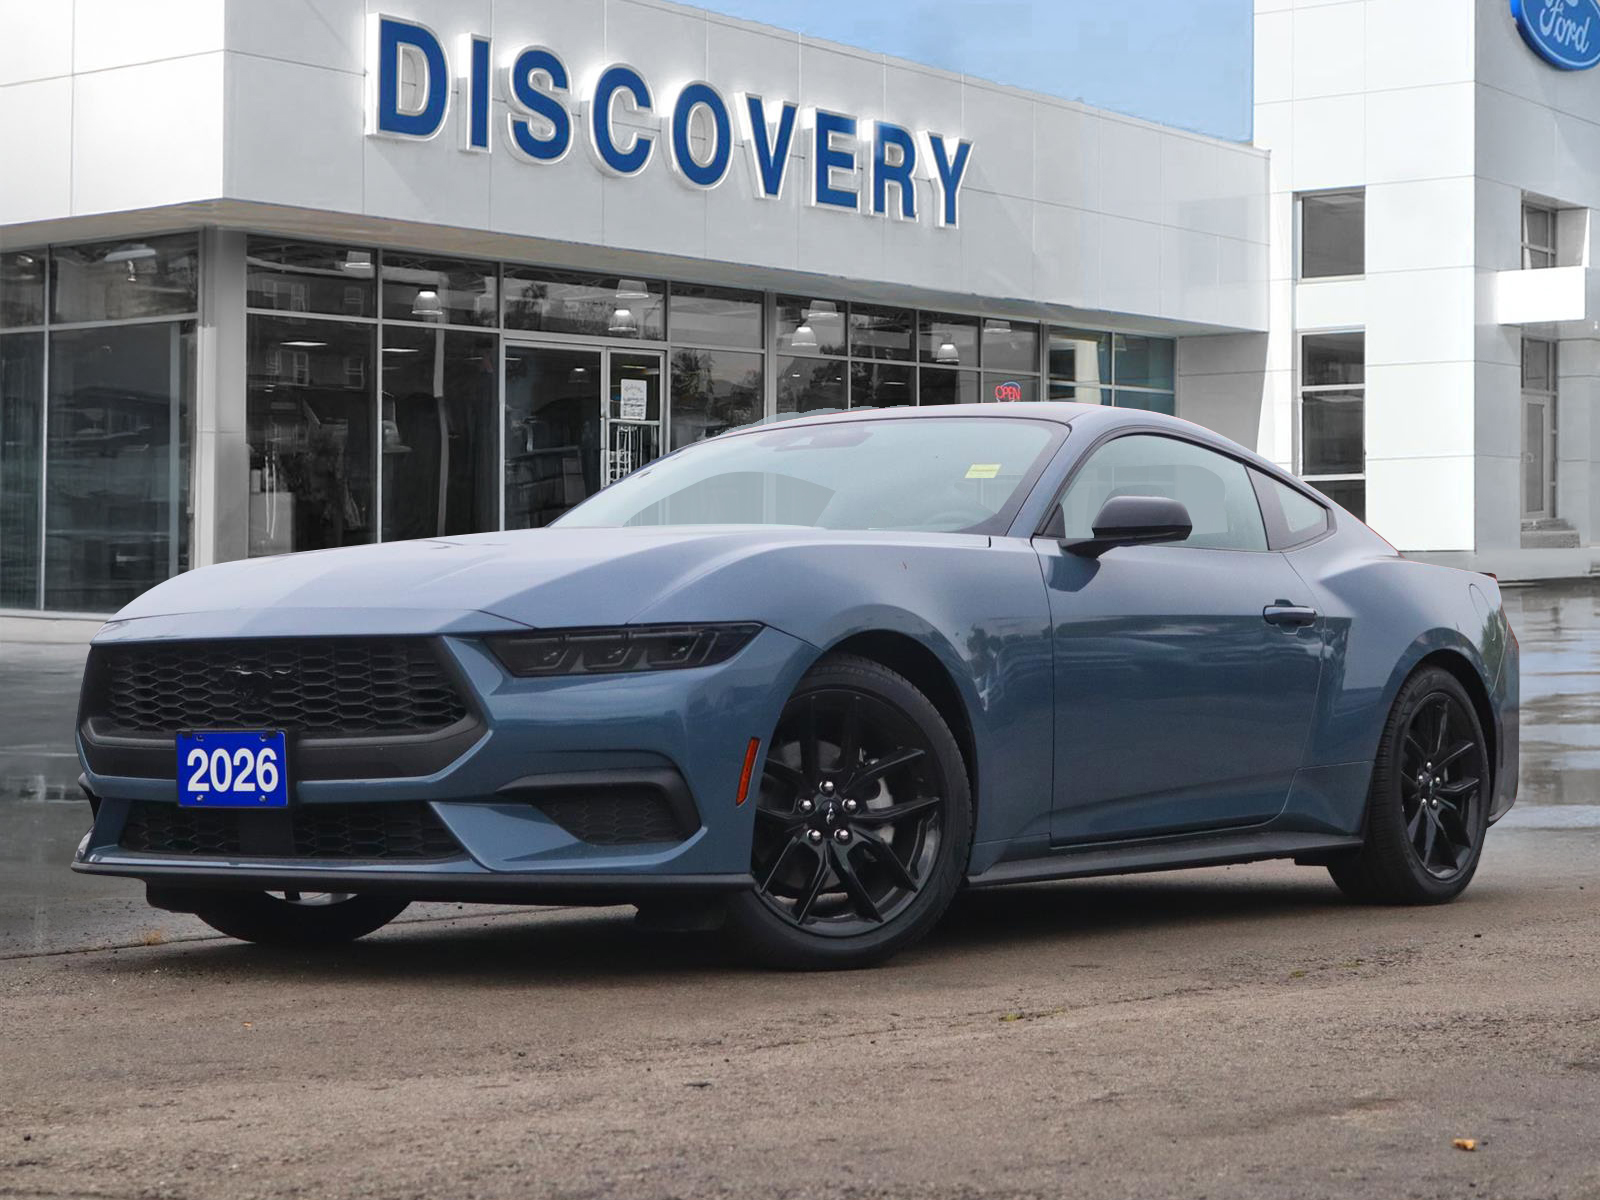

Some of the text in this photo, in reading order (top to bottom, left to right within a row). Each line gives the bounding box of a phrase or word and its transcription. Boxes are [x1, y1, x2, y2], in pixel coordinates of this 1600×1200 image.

[1540, 0, 1590, 53] Ford
[376, 16, 971, 227] DISCOVERY
[995, 385, 1021, 400] OPEN
[187, 747, 279, 792] 2026
